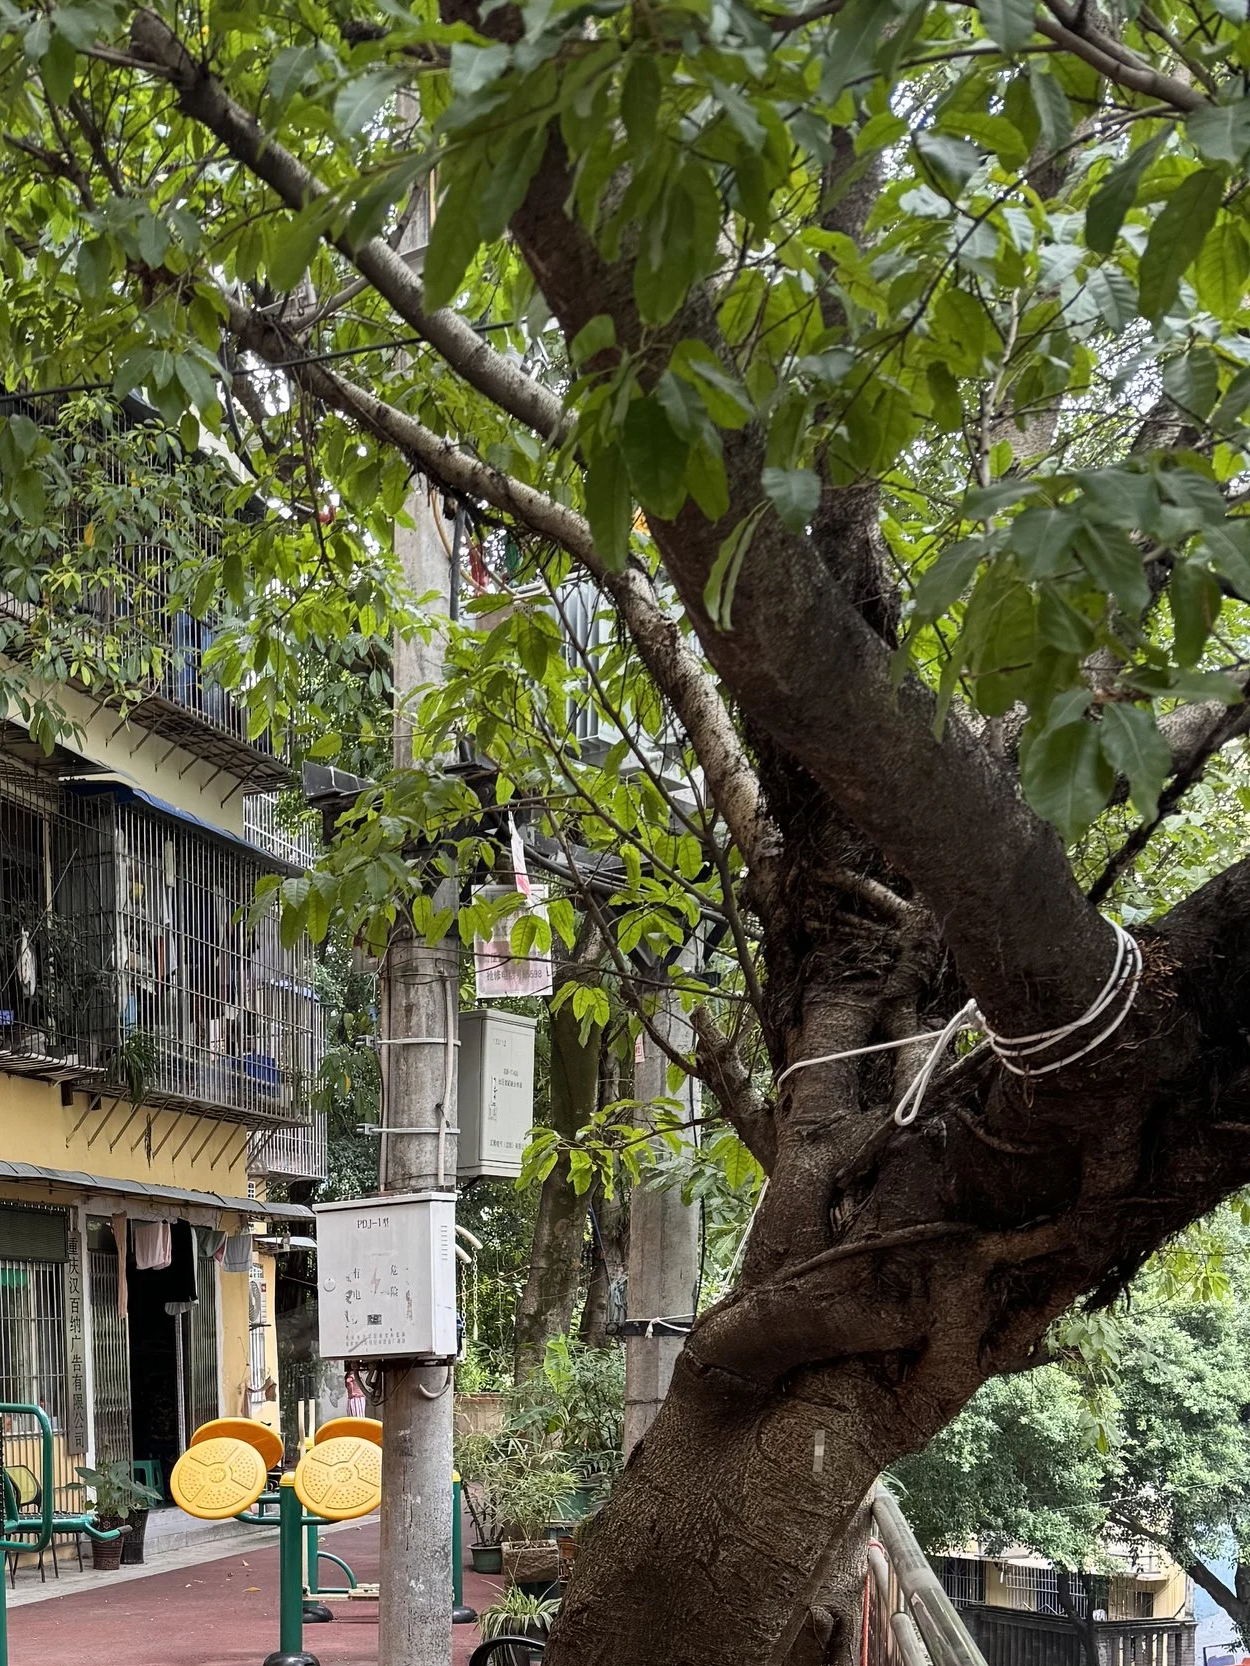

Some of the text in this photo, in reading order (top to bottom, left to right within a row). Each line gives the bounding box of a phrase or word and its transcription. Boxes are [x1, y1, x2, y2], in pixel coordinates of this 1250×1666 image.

[68, 1237, 84, 1448] 重庆汉百纳广告有限公司
